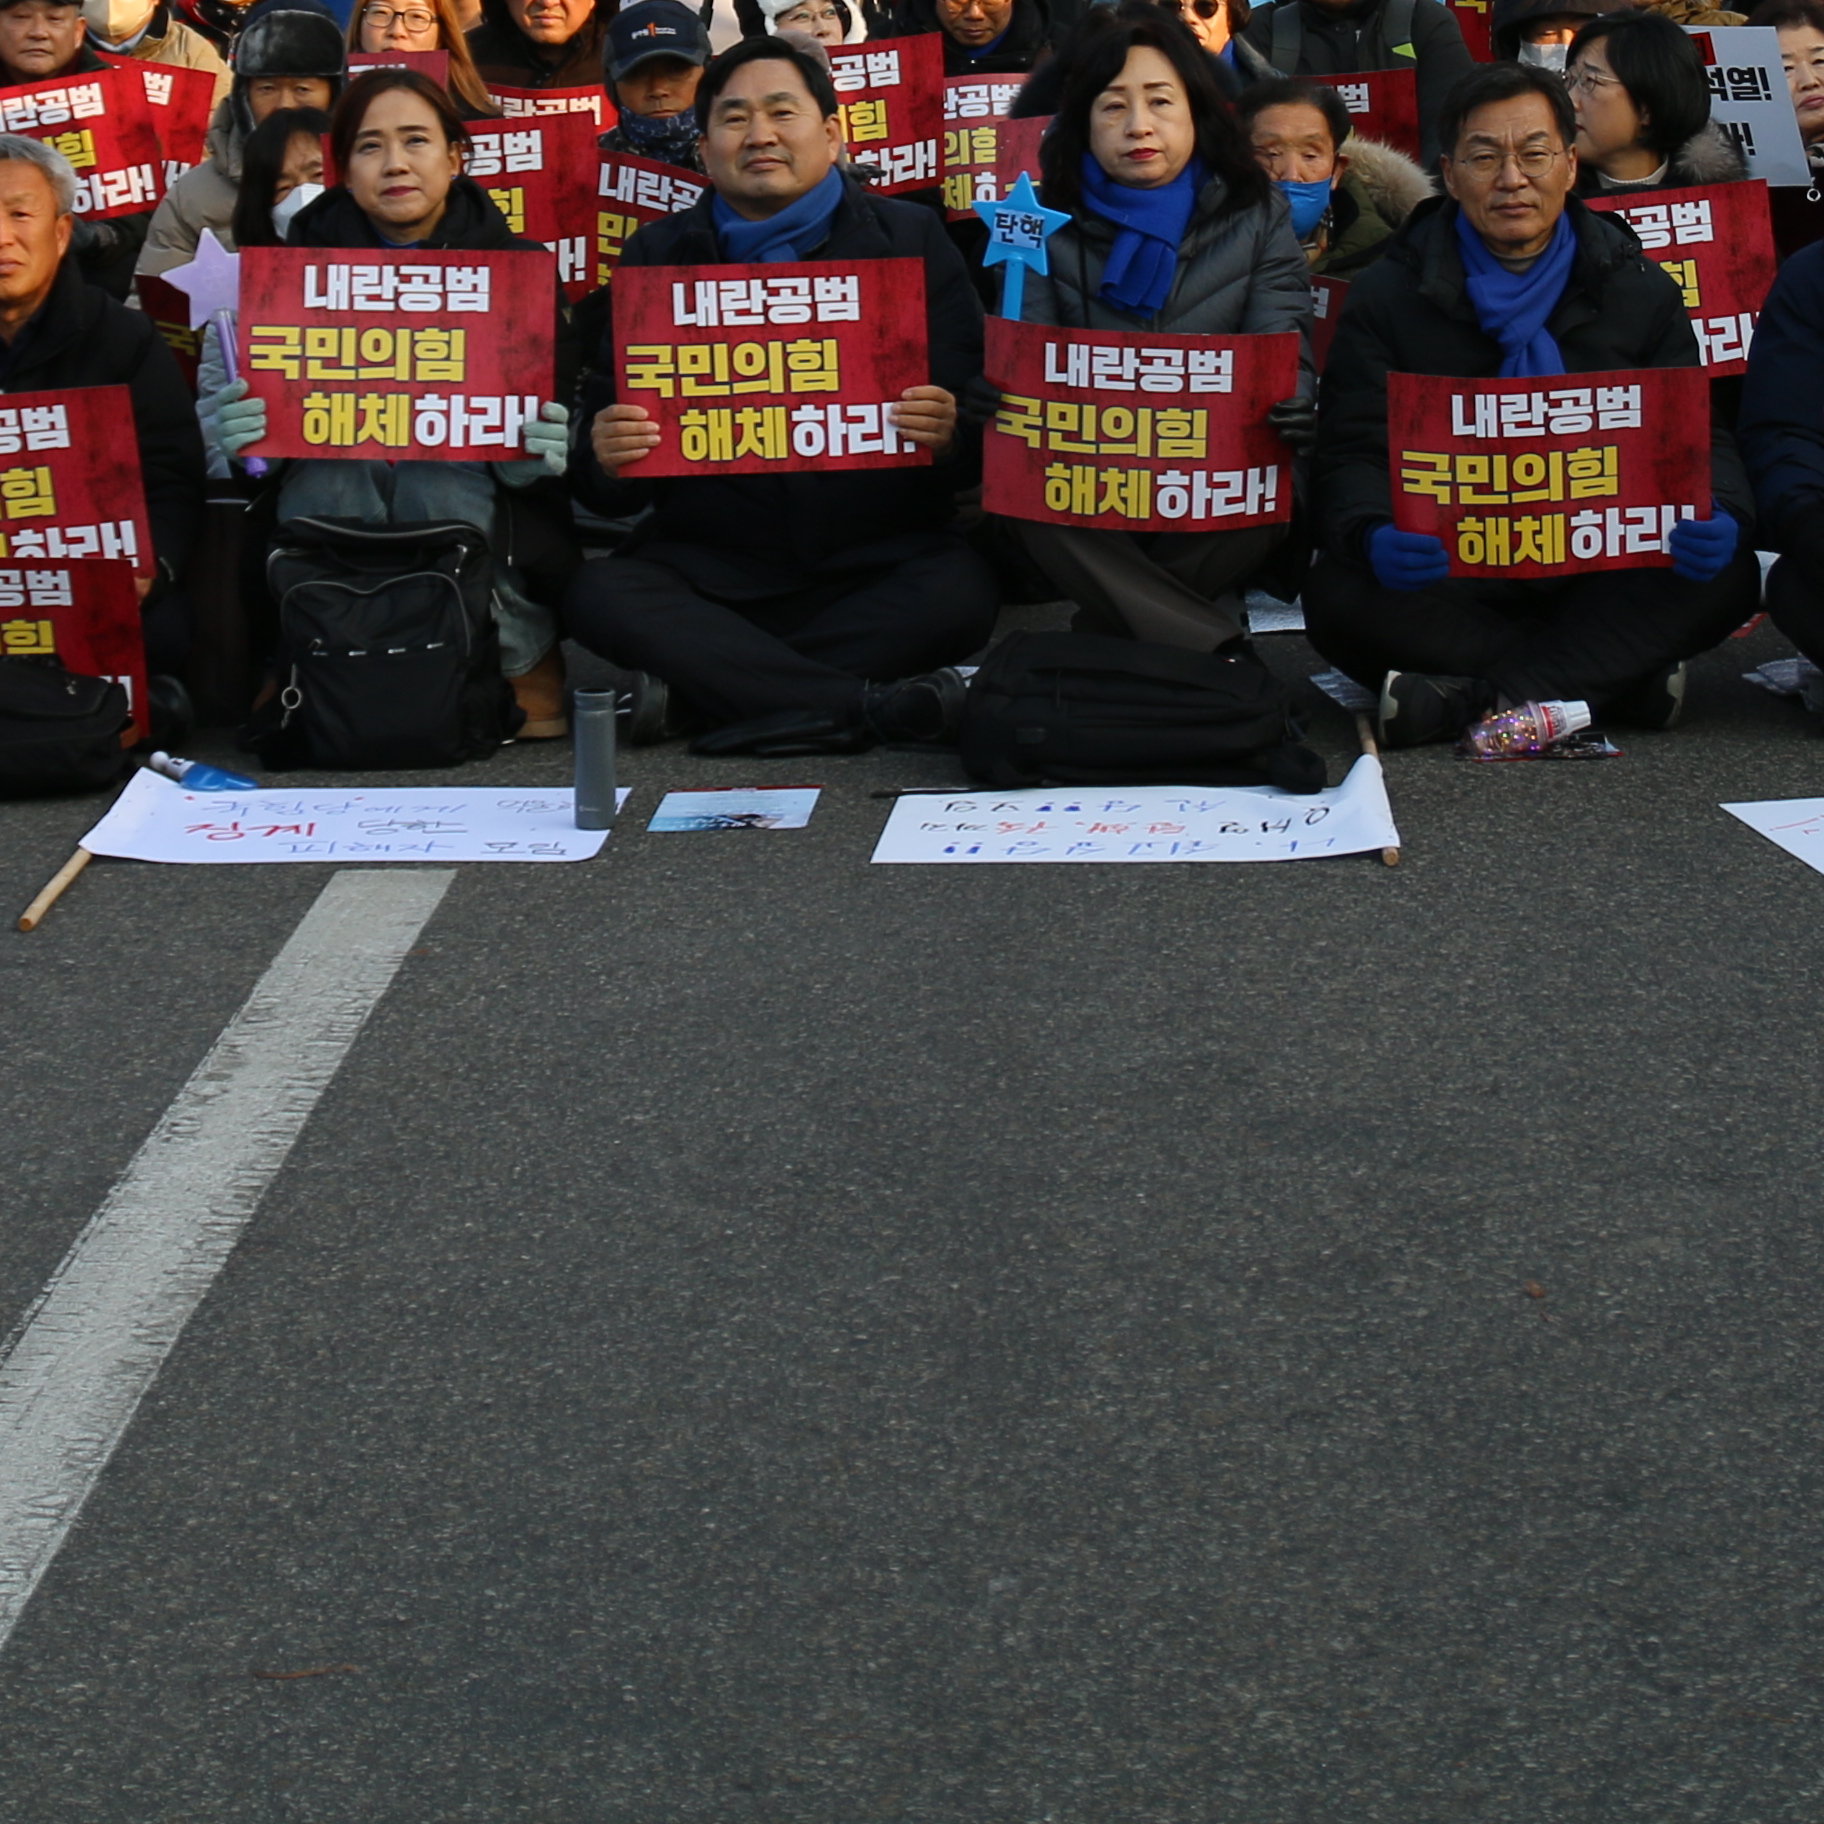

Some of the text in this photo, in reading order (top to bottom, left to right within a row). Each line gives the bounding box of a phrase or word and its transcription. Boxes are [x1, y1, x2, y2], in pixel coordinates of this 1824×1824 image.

[994, 210, 1046, 247] 탄핵
[303, 264, 490, 311] 내란공범
[672, 276, 860, 327] 내란공범
[250, 326, 466, 382] 국민의힘
[624, 339, 838, 399] 국민의힘
[1044, 342, 1234, 394] 내란공범
[995, 397, 1207, 458] 국민의힘
[1452, 386, 1642, 440] 내란공범
[1044, 463, 1278, 522] 해체하라!
[1401, 447, 1619, 504] 국민의힘
[185, 822, 317, 841] 징계
